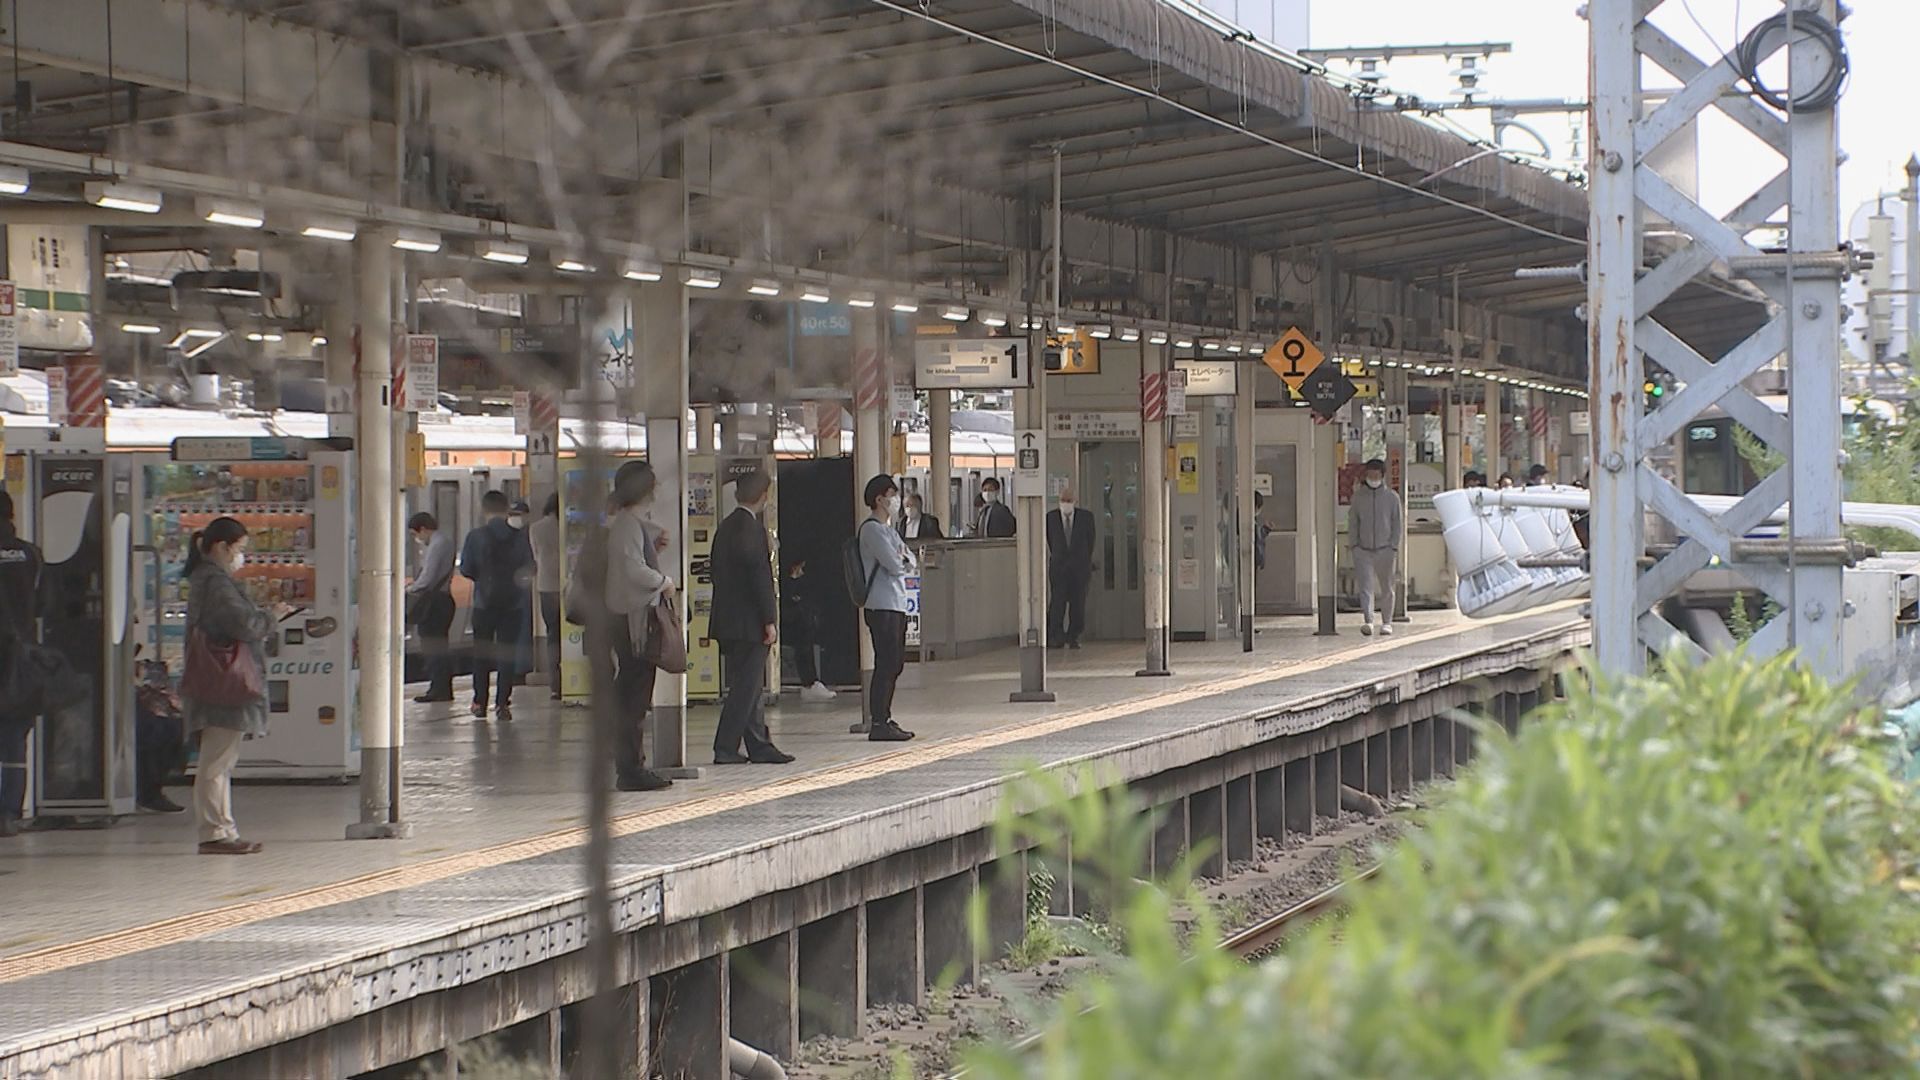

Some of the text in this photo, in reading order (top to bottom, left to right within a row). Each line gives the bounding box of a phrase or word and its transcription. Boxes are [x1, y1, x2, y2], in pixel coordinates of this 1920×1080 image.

[1004, 343, 1018, 379] 1
[1190, 367, 1231, 376] エレベーター
[270, 661, 334, 675] acure
